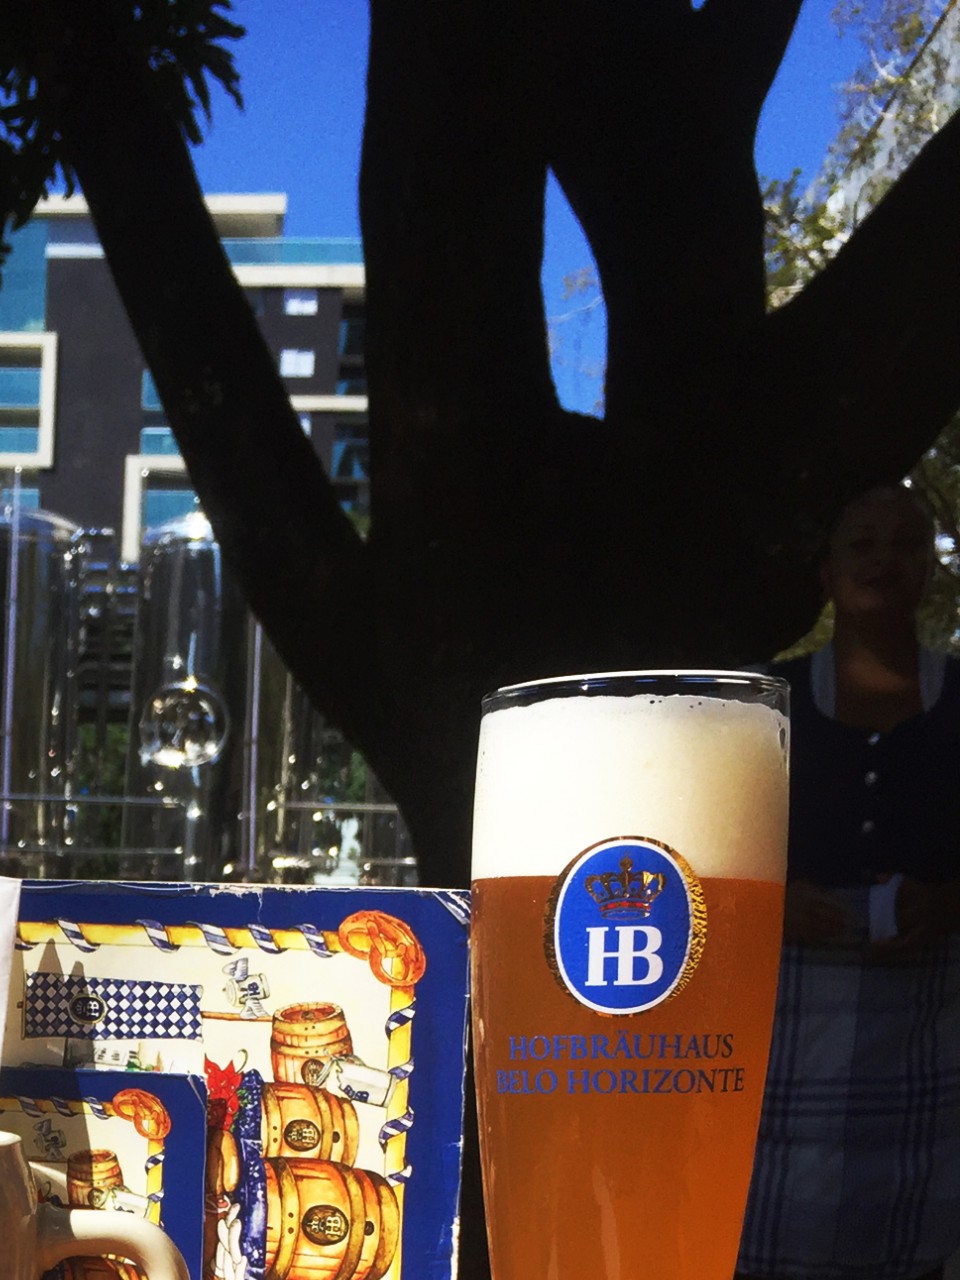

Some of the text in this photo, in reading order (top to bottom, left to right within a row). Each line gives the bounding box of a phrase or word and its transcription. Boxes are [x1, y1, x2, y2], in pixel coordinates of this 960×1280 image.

[584, 925, 664, 986] HB
[508, 1029, 734, 1061] HOFBRÄUHAUS
[496, 1067, 745, 1095] BELO HORIZONTE
